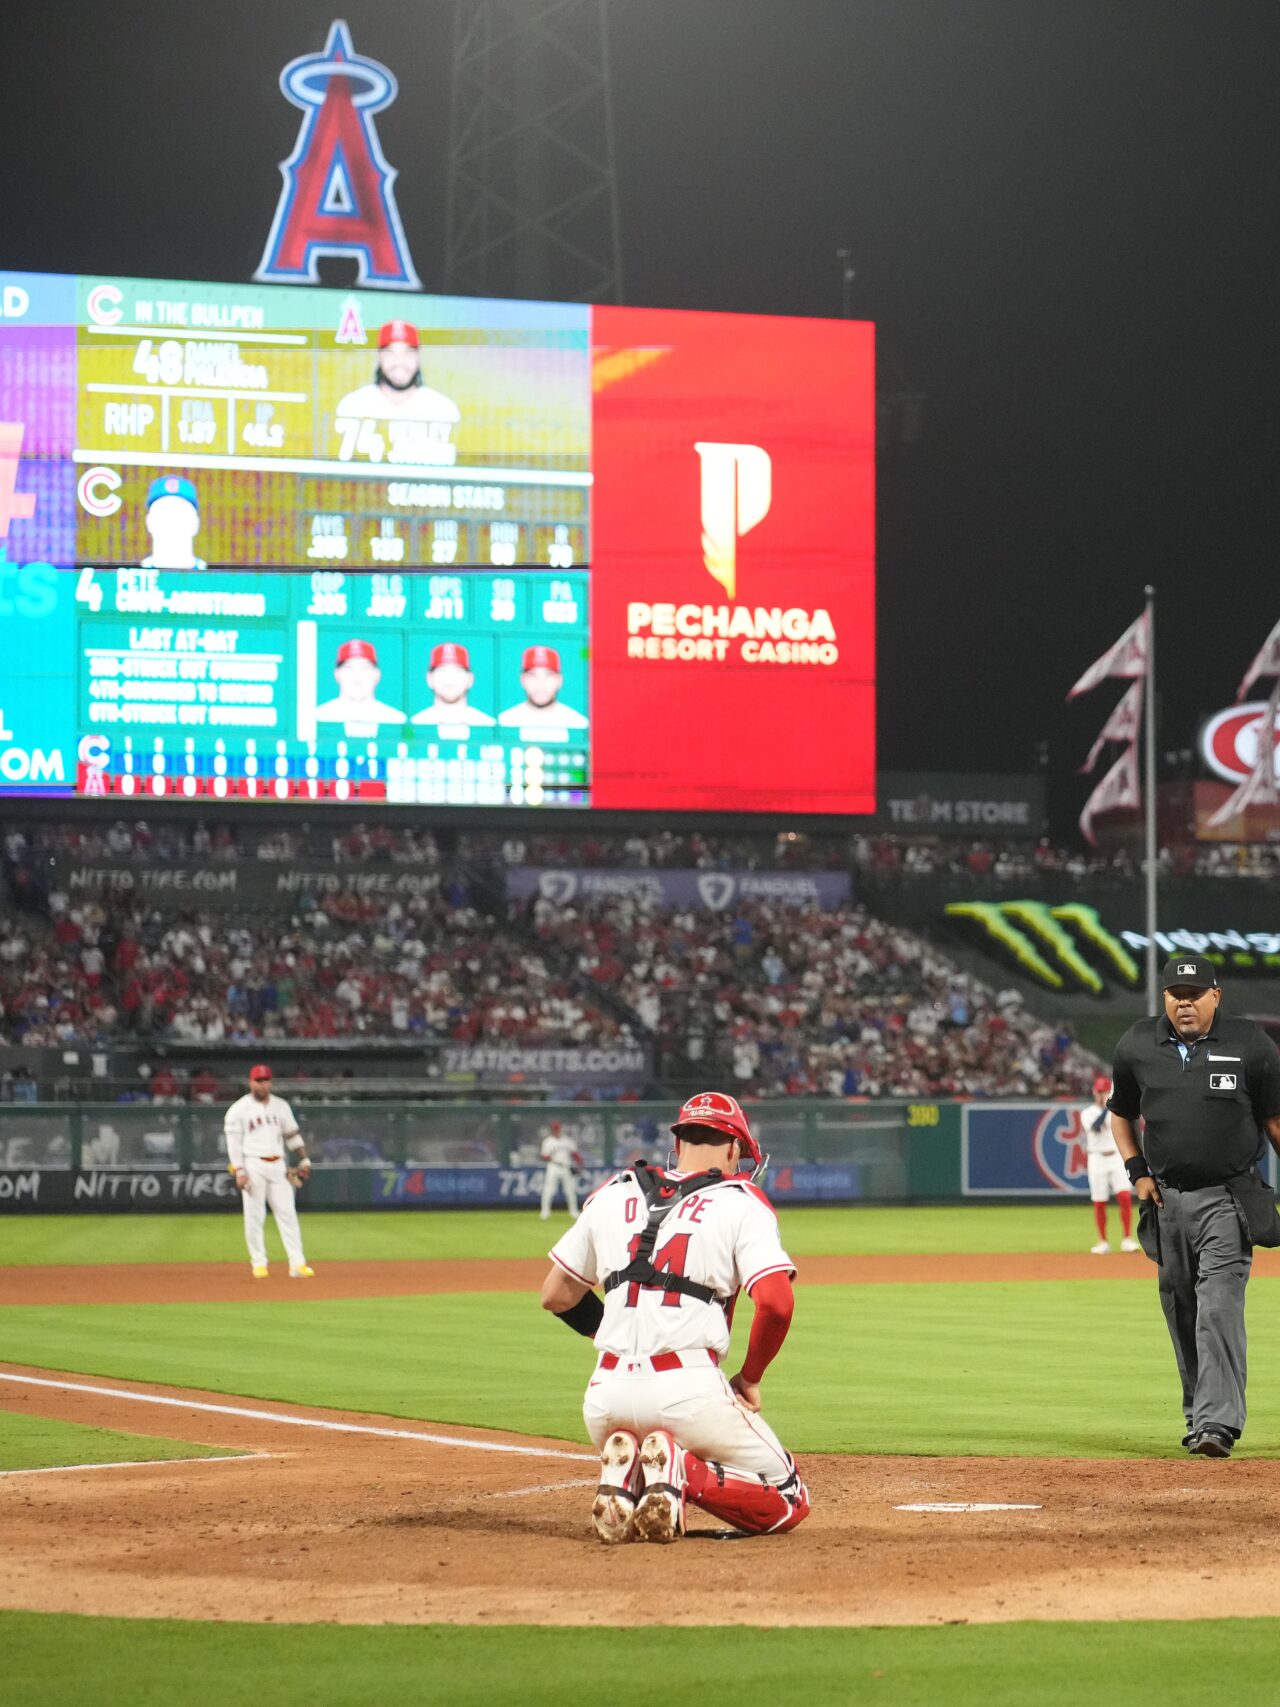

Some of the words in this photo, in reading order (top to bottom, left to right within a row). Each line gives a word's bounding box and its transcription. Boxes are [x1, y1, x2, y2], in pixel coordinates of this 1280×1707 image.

[253, 18, 424, 291] A
[158, 301, 187, 325] THE
[105, 403, 154, 435] RHP
[75, 568, 103, 611] 4
[117, 568, 159, 592] PETE
[627, 601, 836, 640] PECHANGA
[627, 637, 729, 661] RESORT
[741, 640, 838, 665] CASINO
[955, 802, 1029, 824] STORE
[70, 868, 134, 890] NITTO
[277, 870, 340, 891] NITTO
[446, 1049, 644, 1074] 714TICKETS.COM
[74, 1172, 160, 1199] NITTO
[625, 1233, 692, 1308] 14
